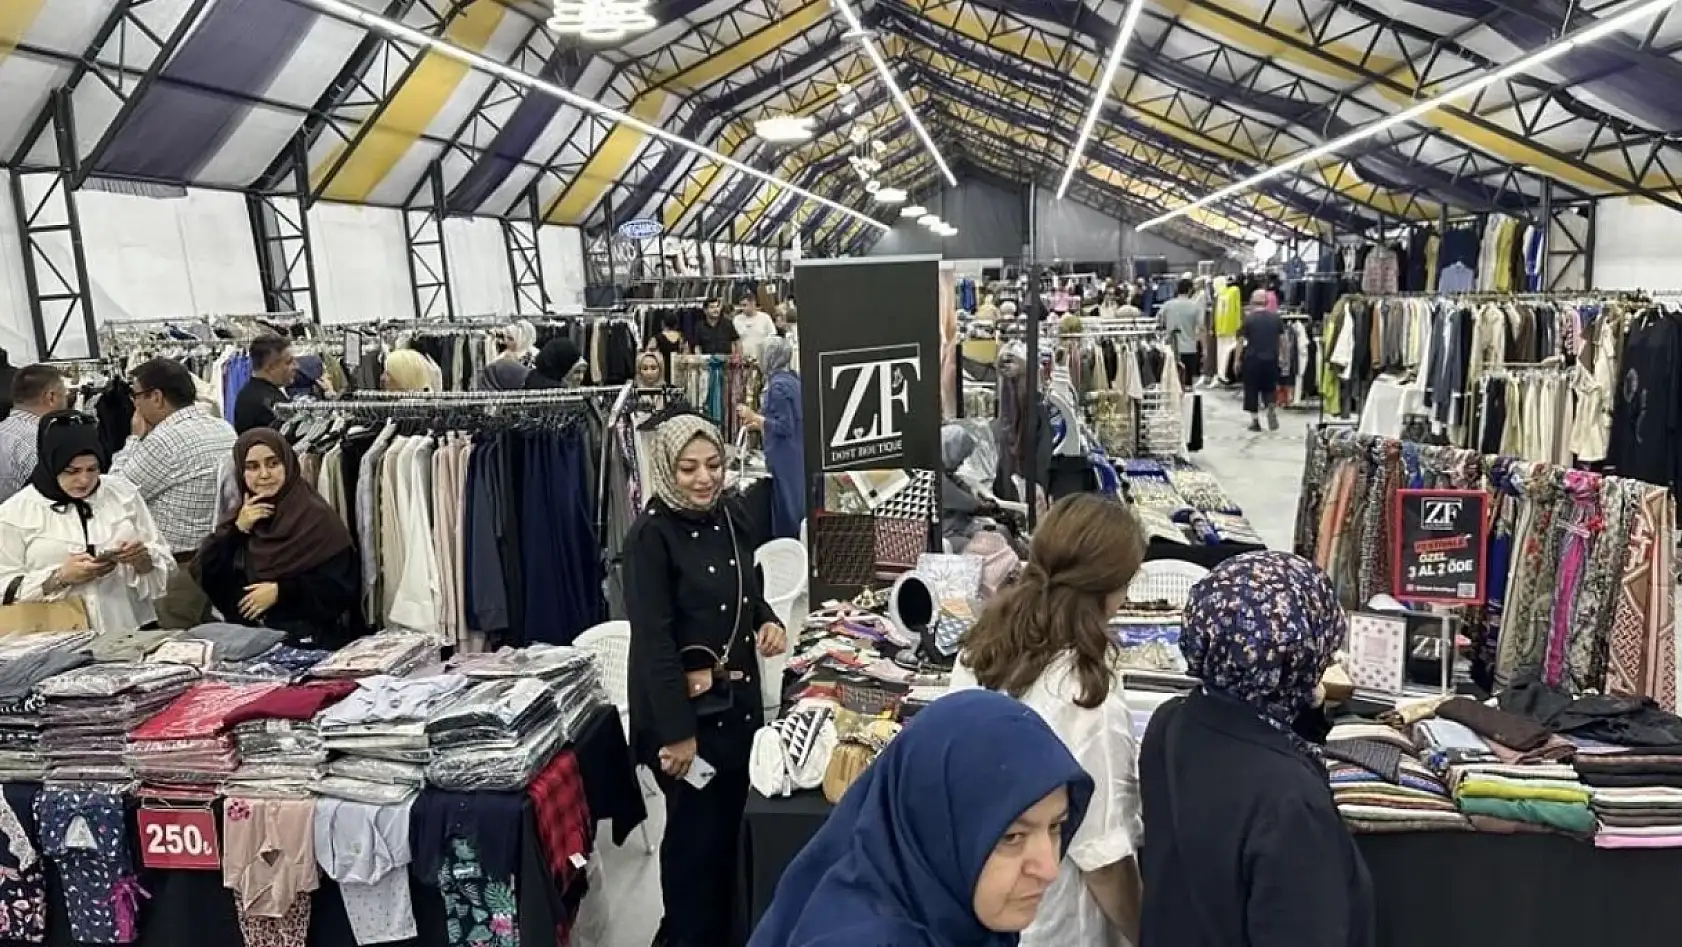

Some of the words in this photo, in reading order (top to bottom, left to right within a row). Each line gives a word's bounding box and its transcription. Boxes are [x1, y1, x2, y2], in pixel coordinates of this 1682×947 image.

[1425, 501, 1463, 524] ZF
[1407, 565, 1417, 579] 3
[1418, 564, 1436, 577] AL
[1437, 562, 1447, 577] 2
[1447, 558, 1474, 574] ÖDE
